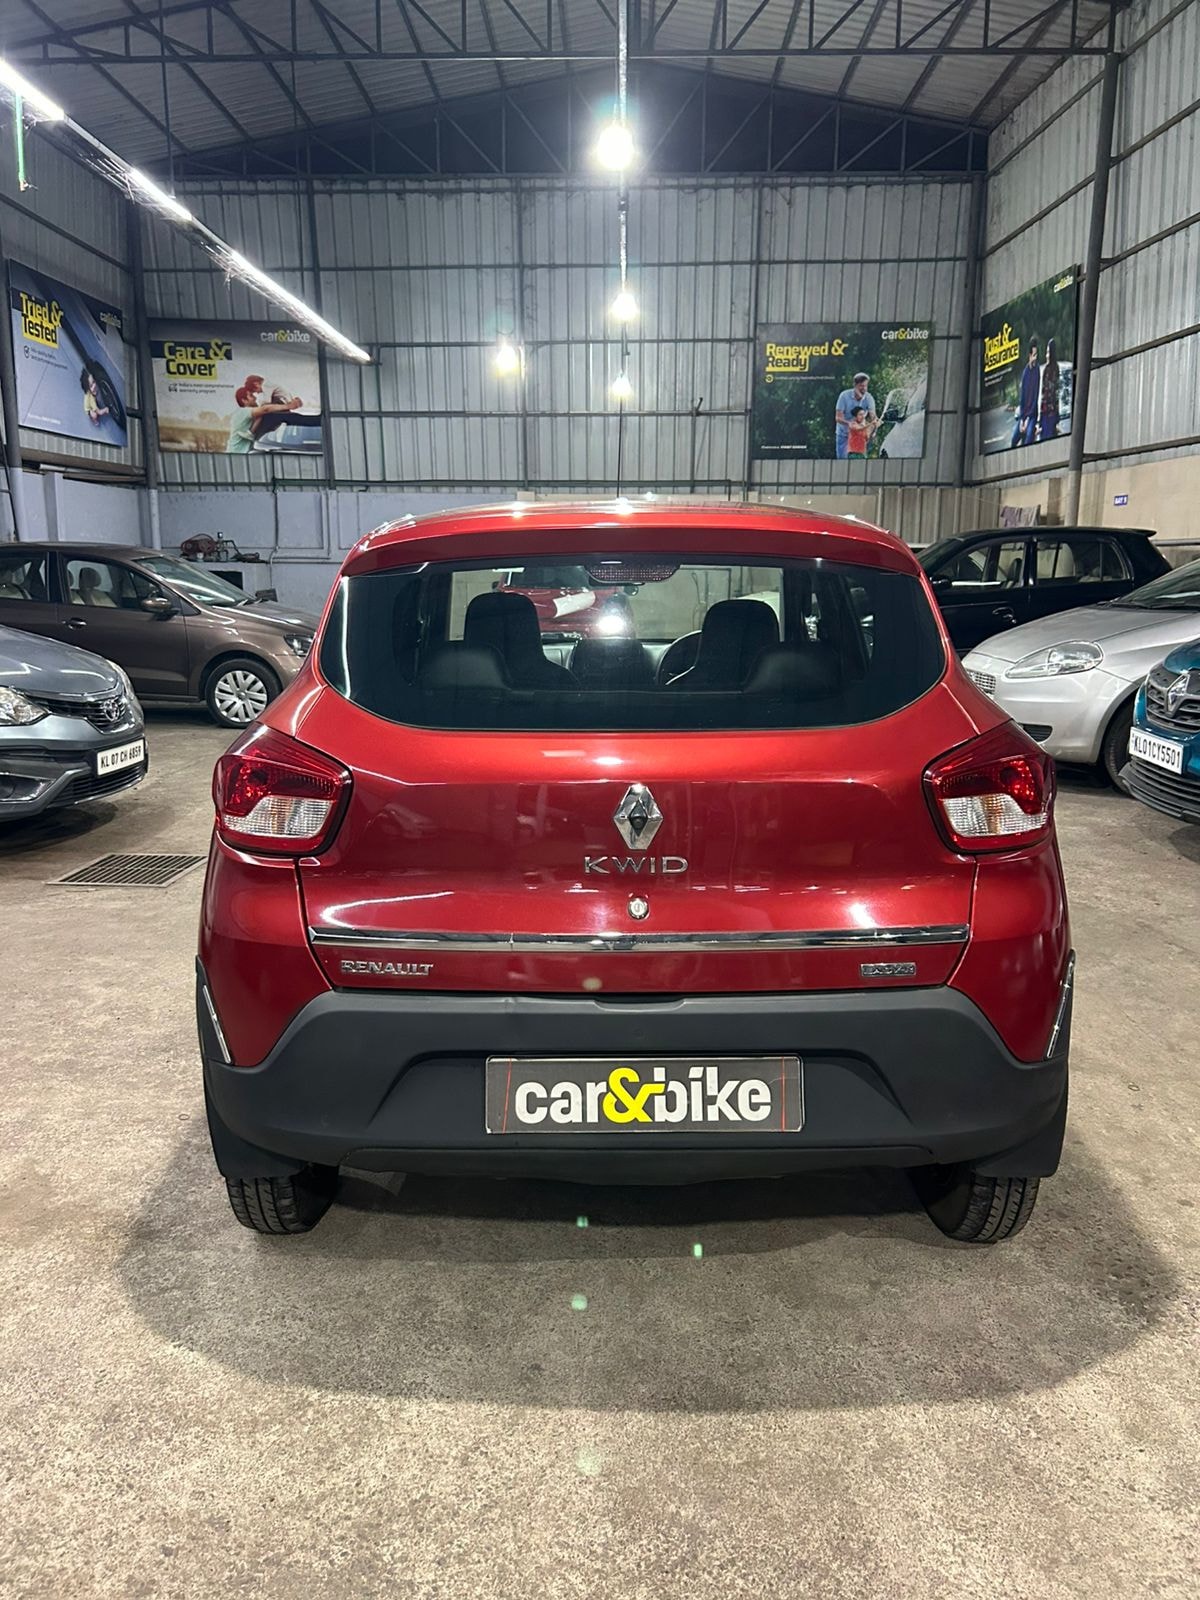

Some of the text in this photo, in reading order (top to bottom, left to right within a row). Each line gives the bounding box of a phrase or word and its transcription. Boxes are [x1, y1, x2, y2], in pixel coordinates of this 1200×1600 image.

[20, 292, 63, 328] Tried &
[21, 313, 58, 345] Tested
[260, 330, 311, 343] car&bike
[881, 327, 929, 340] car&bike
[766, 339, 848, 356] Renewed &
[984, 322, 1012, 355] Trust &
[164, 338, 232, 361] Care &
[984, 343, 1019, 367] Assurance
[166, 359, 216, 377] Cover
[767, 355, 807, 370] Ready
[101, 756, 110, 768] KL
[111, 753, 119, 766] 07
[120, 751, 128, 763] CH
[1133, 737, 1180, 768] KL01CY5501
[584, 856, 688, 874] KWID
[341, 960, 433, 975] RENAULT
[515, 1066, 772, 1124] car&bike
